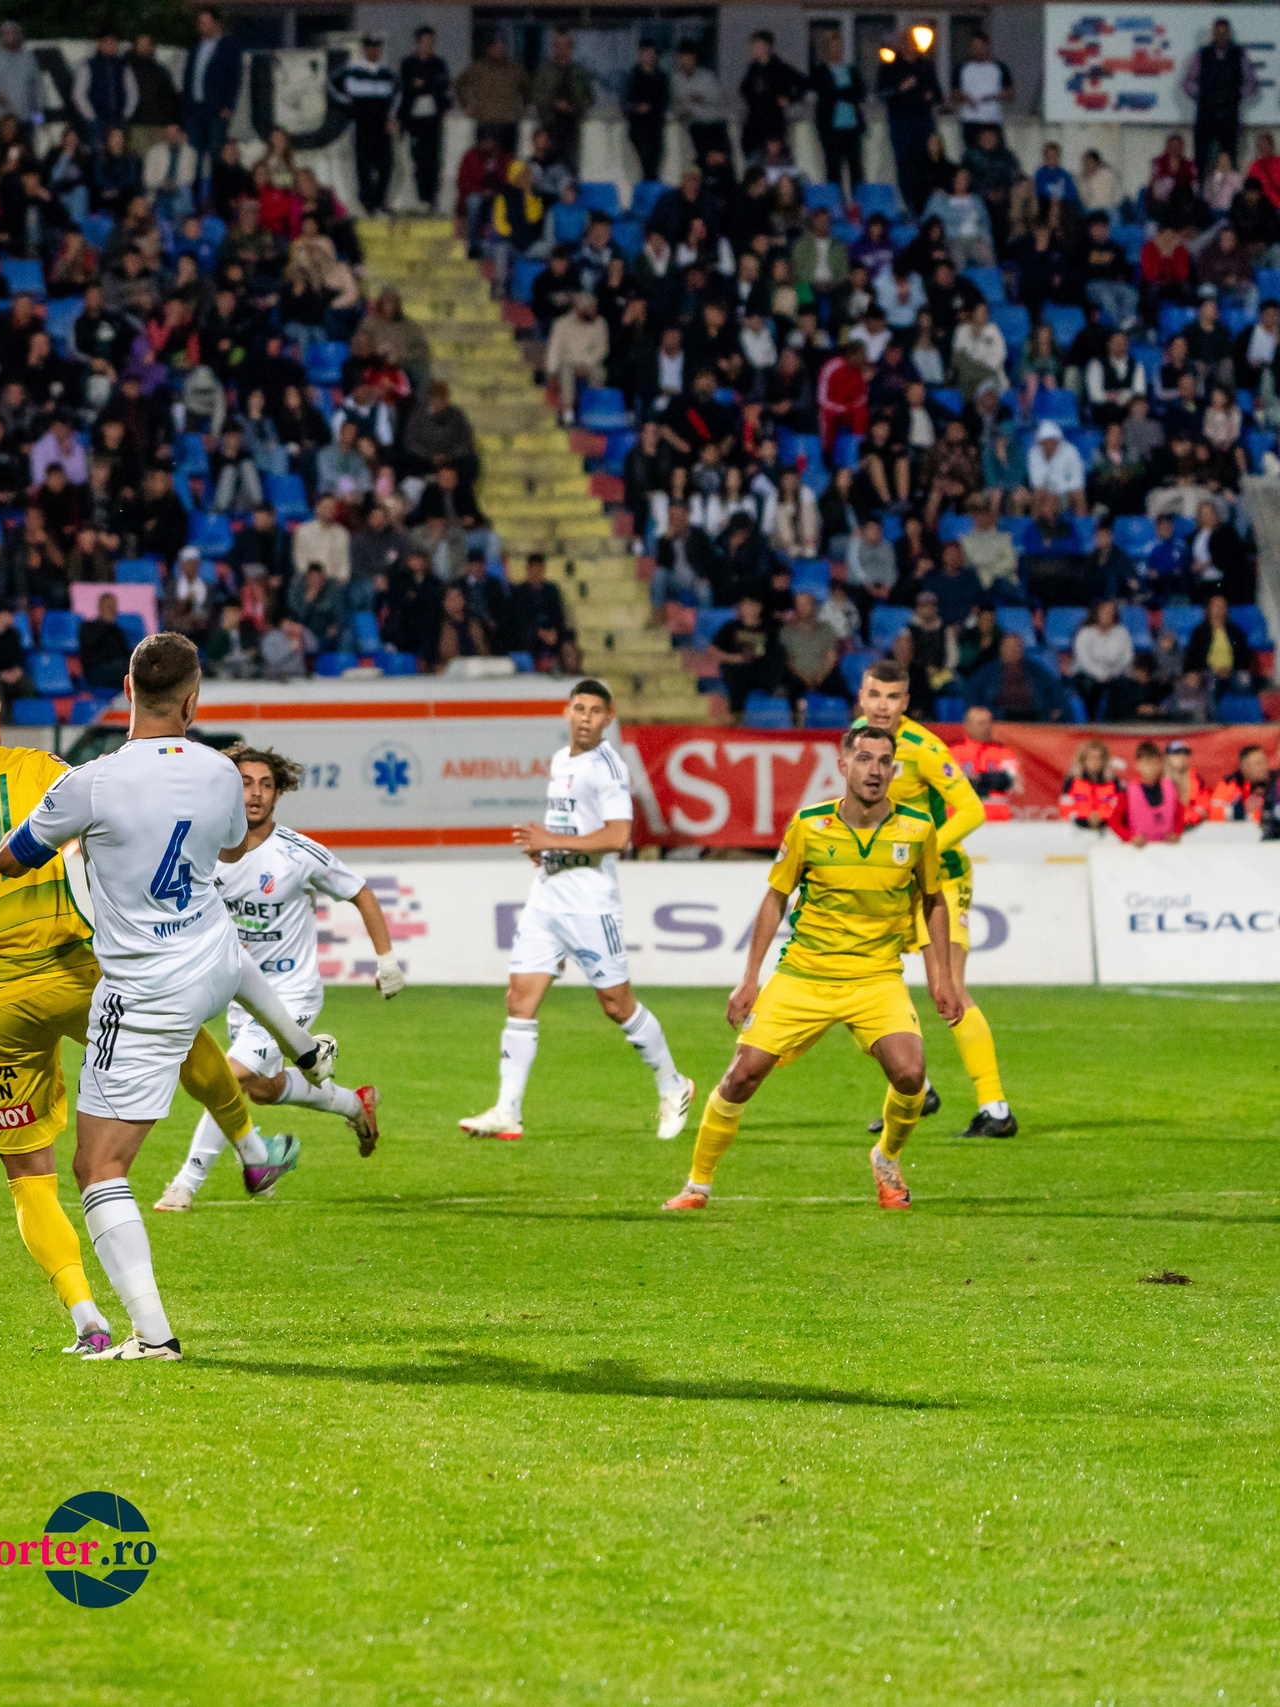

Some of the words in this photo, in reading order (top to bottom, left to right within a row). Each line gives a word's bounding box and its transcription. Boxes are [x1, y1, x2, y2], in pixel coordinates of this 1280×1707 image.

[443, 759, 552, 779] AMBULA
[150, 820, 192, 912] 4
[1129, 910, 1280, 933] ELSAC
